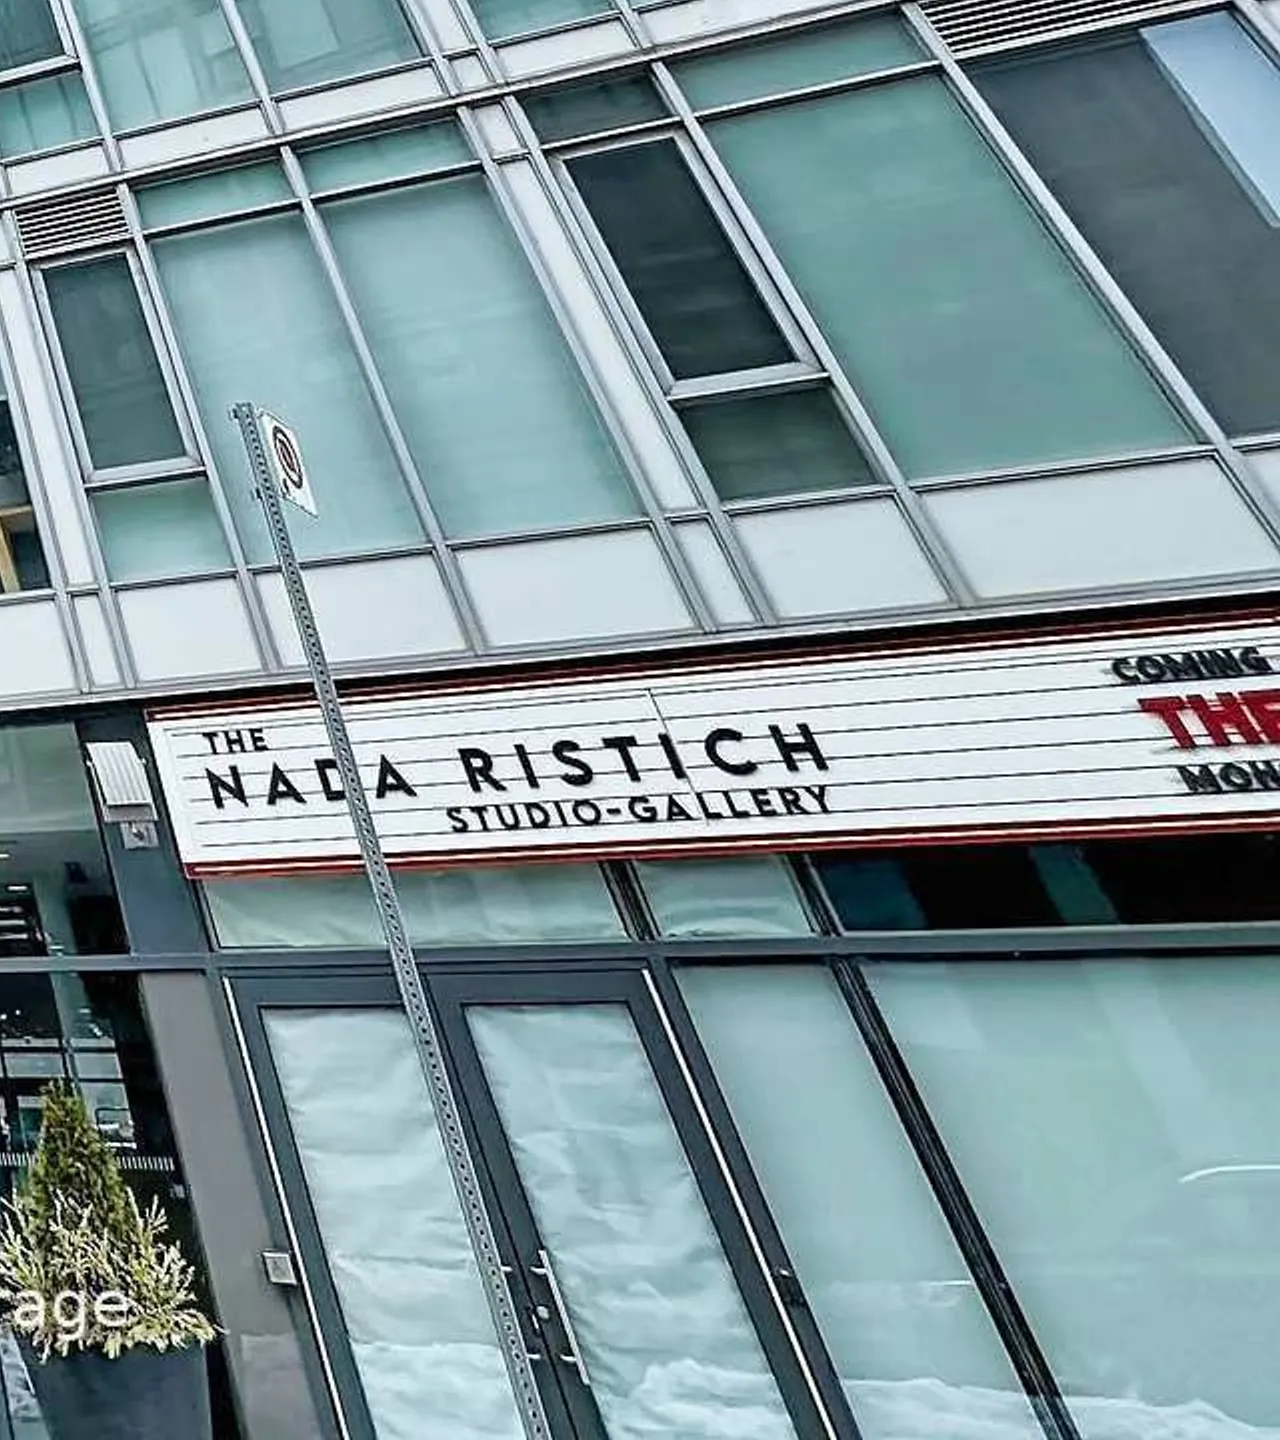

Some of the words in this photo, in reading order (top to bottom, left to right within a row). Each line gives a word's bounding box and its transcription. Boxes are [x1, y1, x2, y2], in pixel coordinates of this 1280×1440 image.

[1111, 646, 1272, 684] COMING
[203, 728, 269, 755] THE
[457, 722, 829, 793] RISTICH
[446, 784, 830, 833] STUDIO-GALLERY
